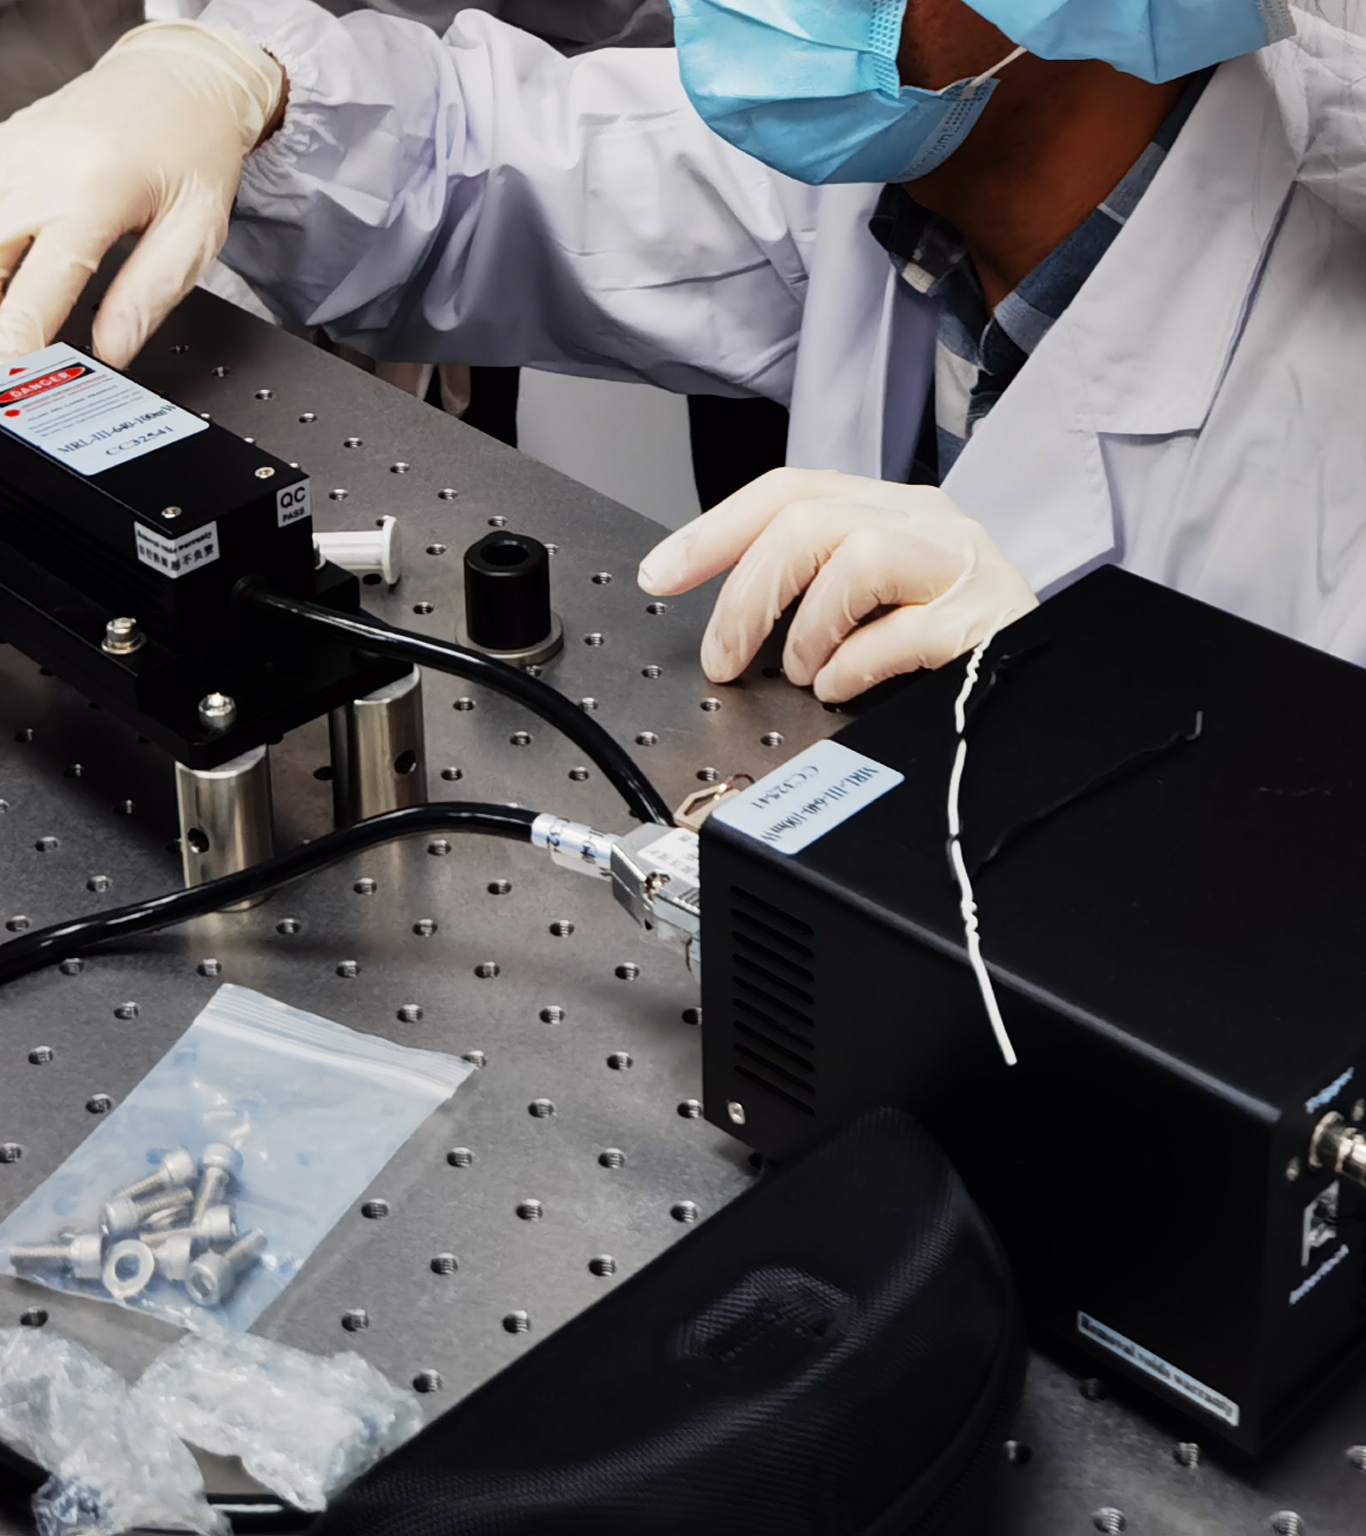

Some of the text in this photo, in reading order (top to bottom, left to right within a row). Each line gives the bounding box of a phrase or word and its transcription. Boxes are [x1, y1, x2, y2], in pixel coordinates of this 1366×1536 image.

[10, 371, 70, 398] DANGER
[280, 486, 306, 509] QC
[282, 506, 305, 523] PASS
